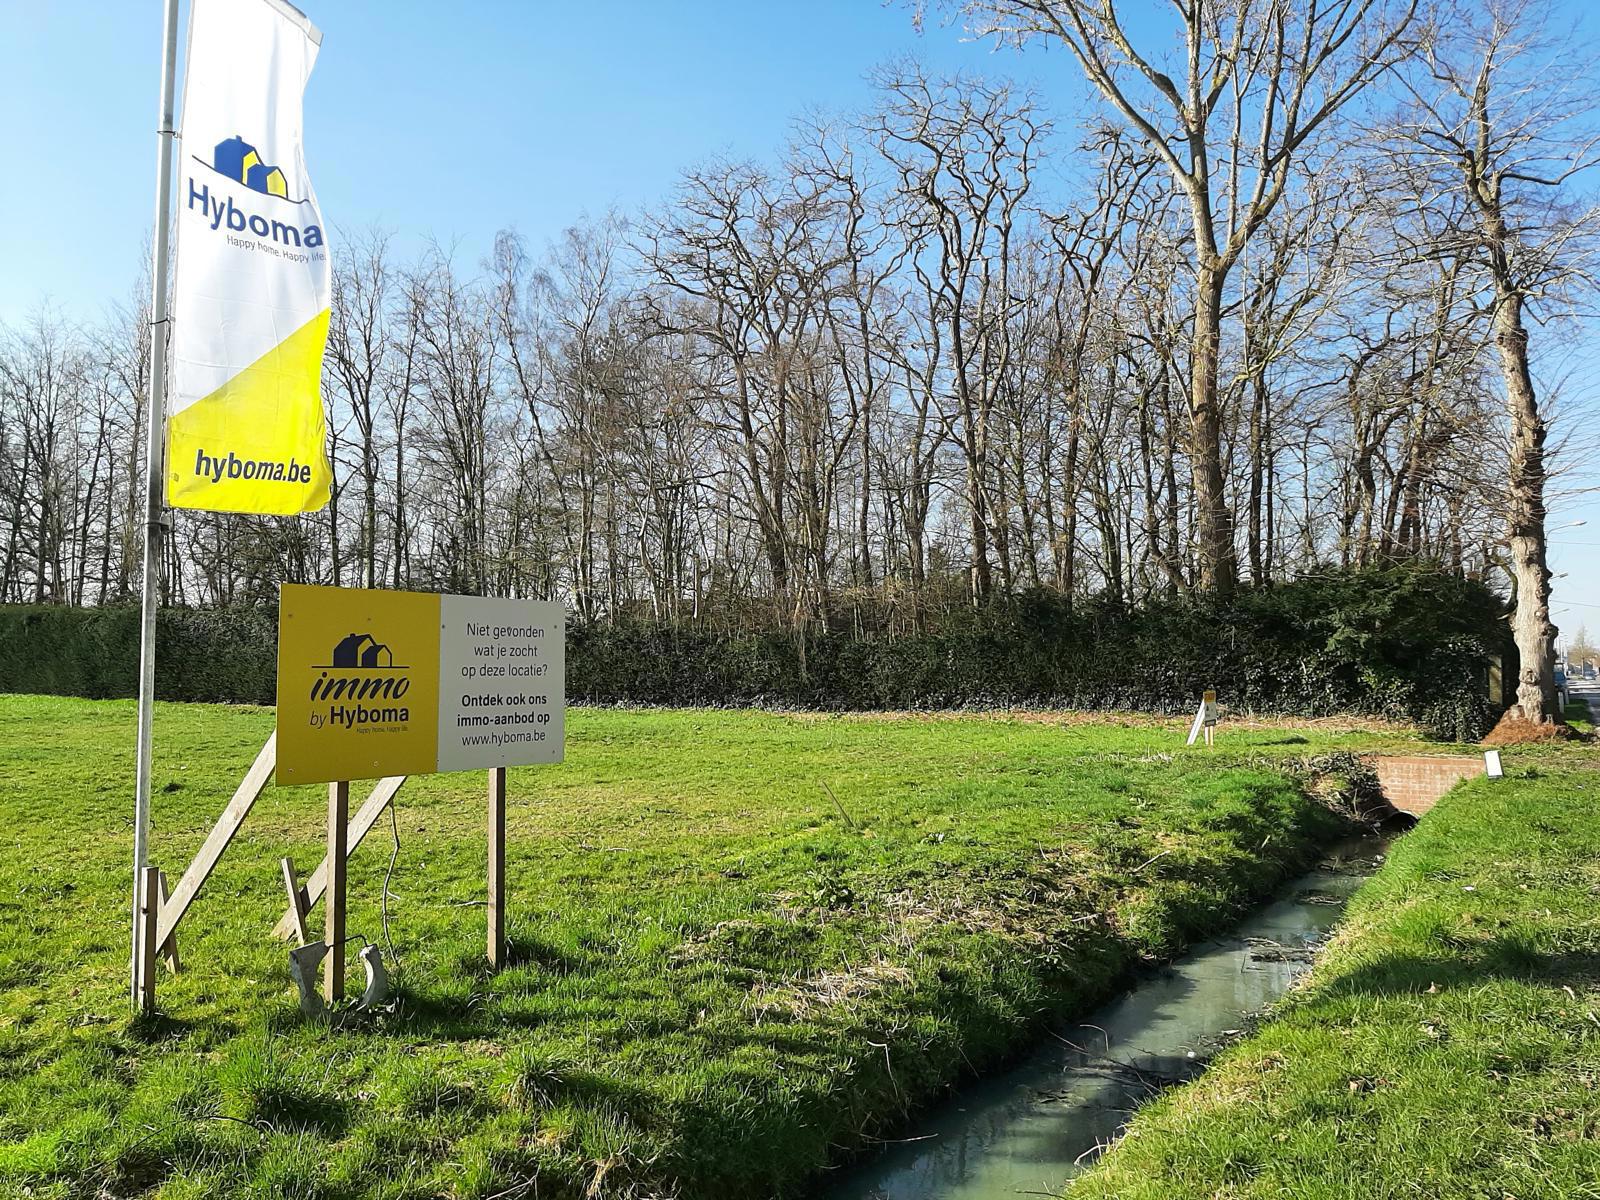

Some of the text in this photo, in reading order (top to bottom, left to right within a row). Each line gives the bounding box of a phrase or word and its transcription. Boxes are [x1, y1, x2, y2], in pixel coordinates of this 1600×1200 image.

[188, 176, 324, 248] Hyboma
[226, 234, 256, 251] Happy
[257, 240, 282, 257] home.
[282, 250, 309, 264] Happy
[195, 448, 311, 484] hyboma.be
[466, 622, 545, 640] Niet gevonden
[474, 643, 538, 660] wat je zocht
[461, 664, 548, 679] op deze locatie?
[310, 671, 410, 702] immo
[461, 693, 547, 707] Ontdek ook ons
[309, 704, 409, 730] by Hyboma
[457, 711, 550, 727] immo-aanbod op
[461, 729, 546, 747] www.hyboma.be
